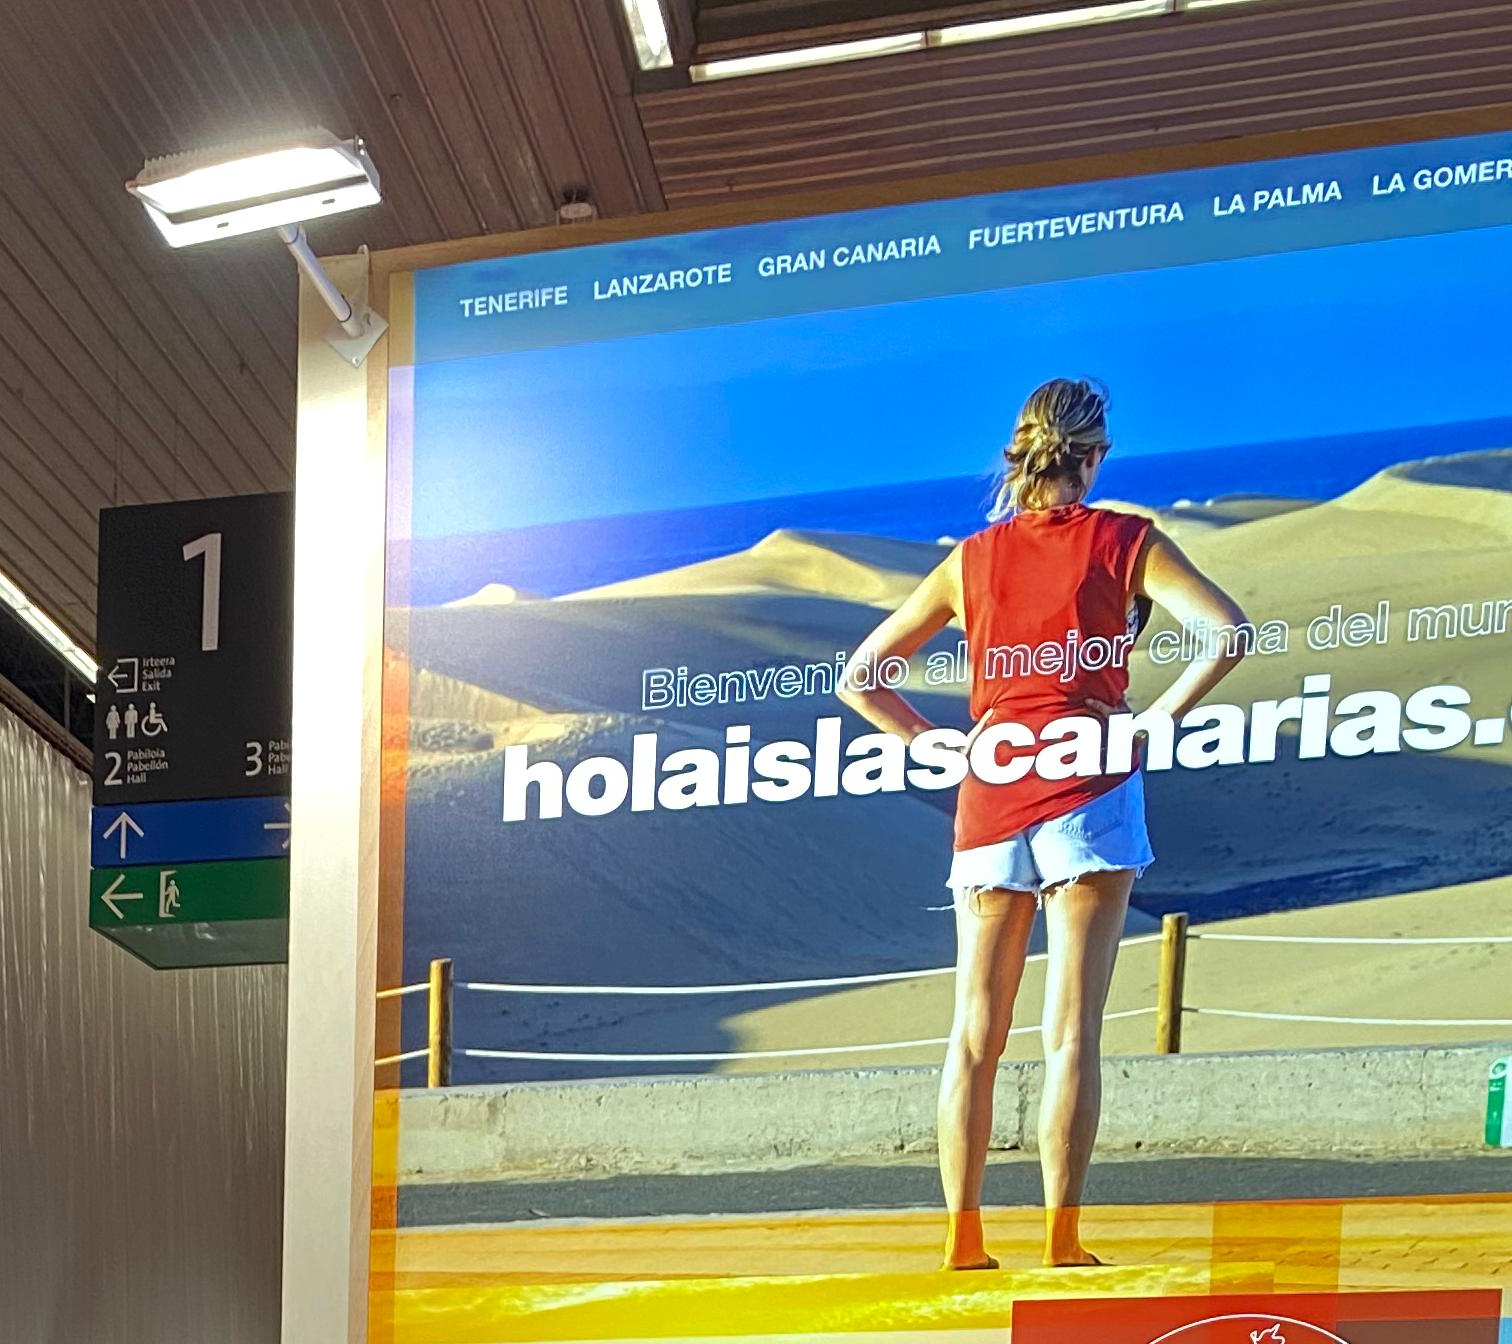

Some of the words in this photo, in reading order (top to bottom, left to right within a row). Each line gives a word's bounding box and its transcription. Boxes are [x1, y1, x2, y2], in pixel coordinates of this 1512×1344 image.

[1212, 194, 1246, 217] LA
[1252, 180, 1343, 213] PALMA
[1371, 173, 1406, 196] LA
[968, 201, 1185, 250] FUERTEVENTURA
[757, 249, 826, 278] GRAN
[832, 235, 942, 267] CANARIA
[593, 263, 733, 301] LANZAROTE
[459, 284, 569, 318] TENERIFE
[182, 532, 222, 652] 1
[142, 667, 172, 680] Salida
[641, 652, 910, 711] Bienvenido
[924, 640, 968, 685] al
[984, 628, 1135, 683] mejor
[1149, 614, 1288, 664] clima
[1306, 600, 1390, 651] del
[142, 681, 161, 692] Exit
[245, 742, 263, 776] 3
[503, 673, 1512, 822] holaislascanarias.
[104, 751, 123, 786] 2
[126, 772, 147, 784] Hall
